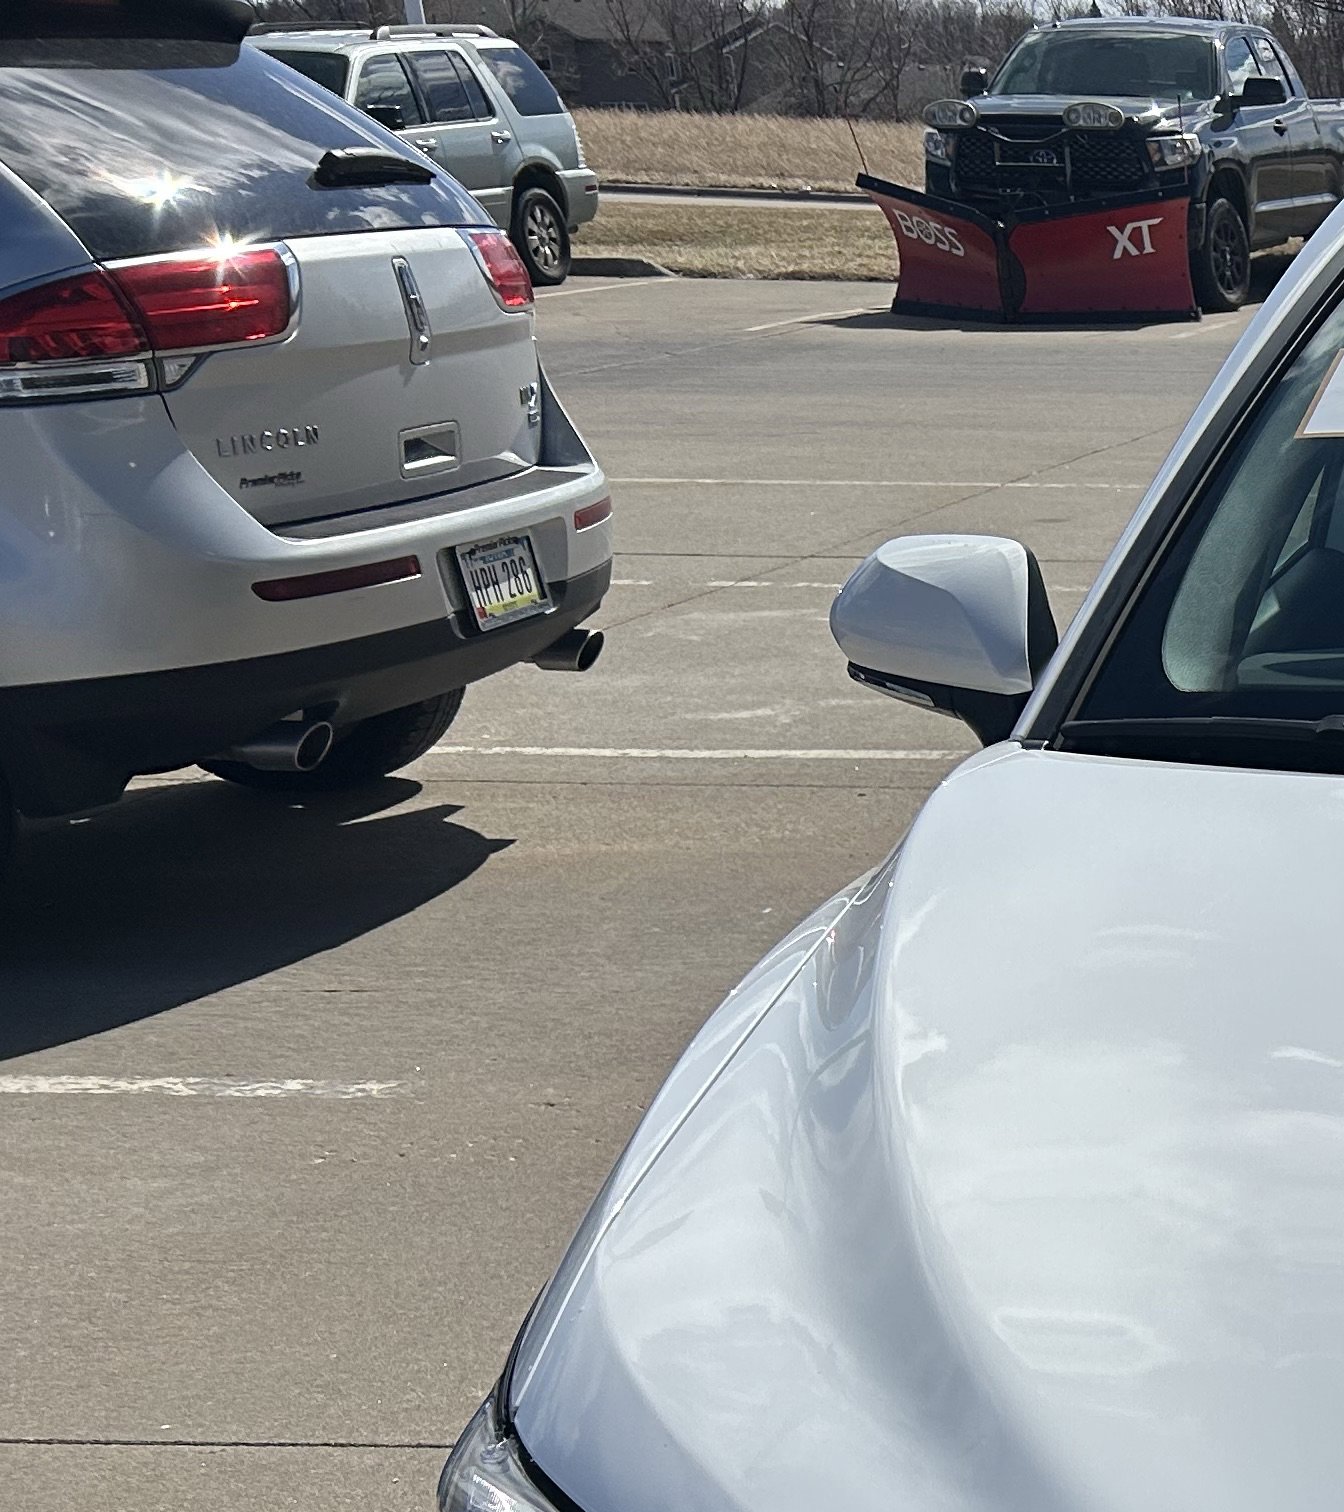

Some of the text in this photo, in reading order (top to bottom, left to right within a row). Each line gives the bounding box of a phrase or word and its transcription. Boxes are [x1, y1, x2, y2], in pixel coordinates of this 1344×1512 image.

[891, 208, 965, 257] BOSS
[1106, 217, 1164, 259] XT
[216, 425, 319, 458] LINCOLN
